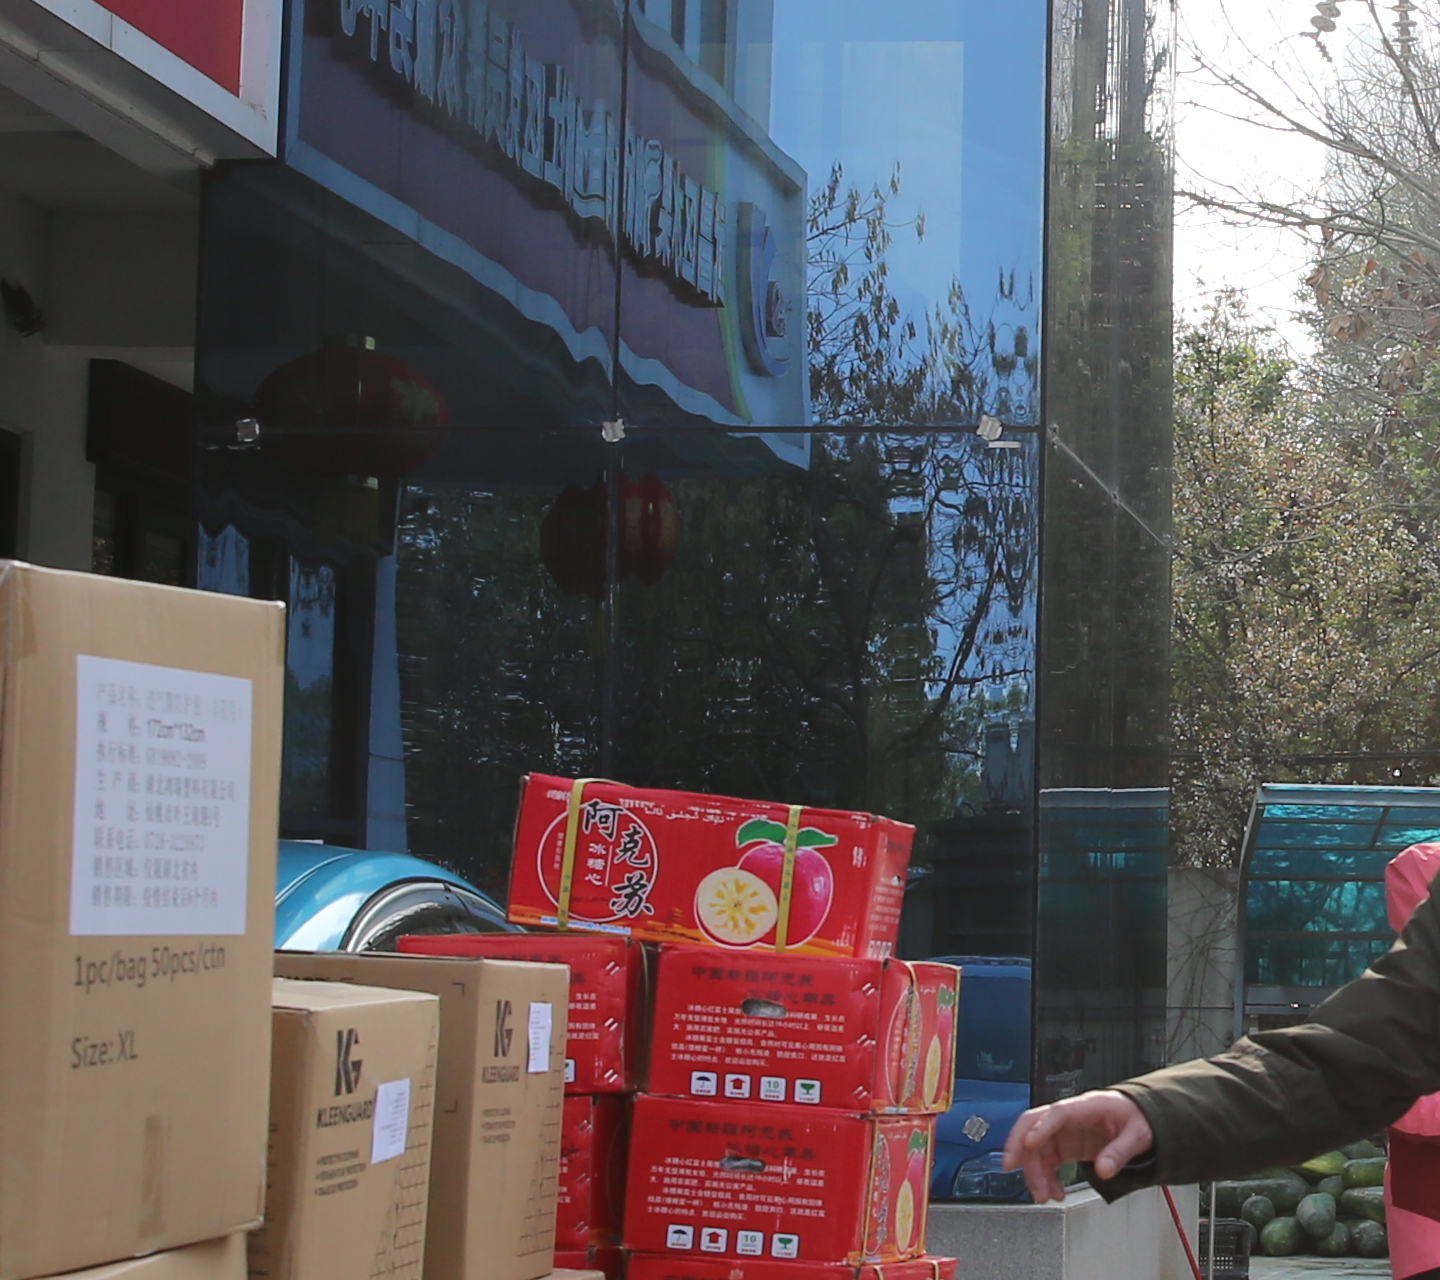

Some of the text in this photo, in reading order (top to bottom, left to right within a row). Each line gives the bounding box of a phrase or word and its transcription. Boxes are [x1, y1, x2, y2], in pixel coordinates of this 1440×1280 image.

[582, 798, 656, 918] 阿克苏
[73, 944, 226, 992] 1pc/bag 50pcs/ctn
[70, 1034, 137, 1069] Size: XL
[481, 1064, 520, 1084] KLEENGUARD
[767, 1080, 779, 1088] 10
[316, 1099, 373, 1129] KLEENGUARD
[744, 1234, 756, 1243] 10
